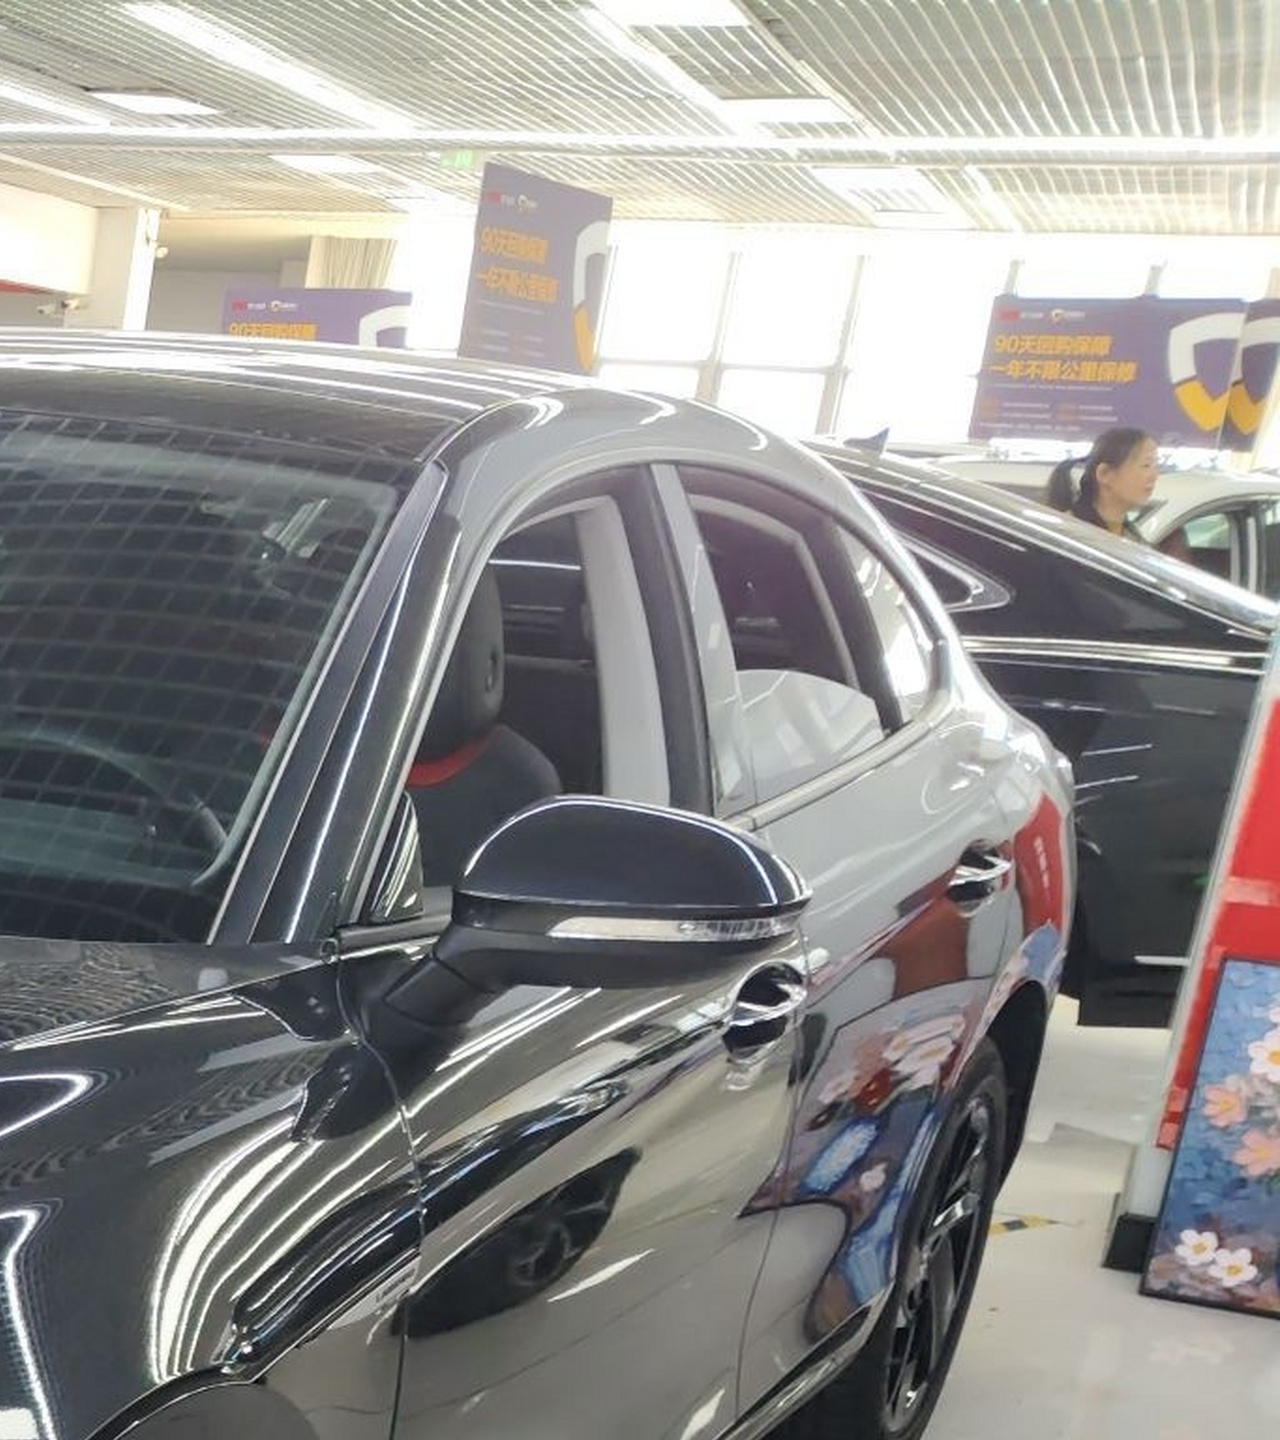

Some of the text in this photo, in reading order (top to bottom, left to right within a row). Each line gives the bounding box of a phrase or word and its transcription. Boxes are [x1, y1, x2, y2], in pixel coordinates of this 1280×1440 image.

[994, 334, 1113, 356] 90天回购保障
[989, 360, 1138, 383] 一年不限公里保修
